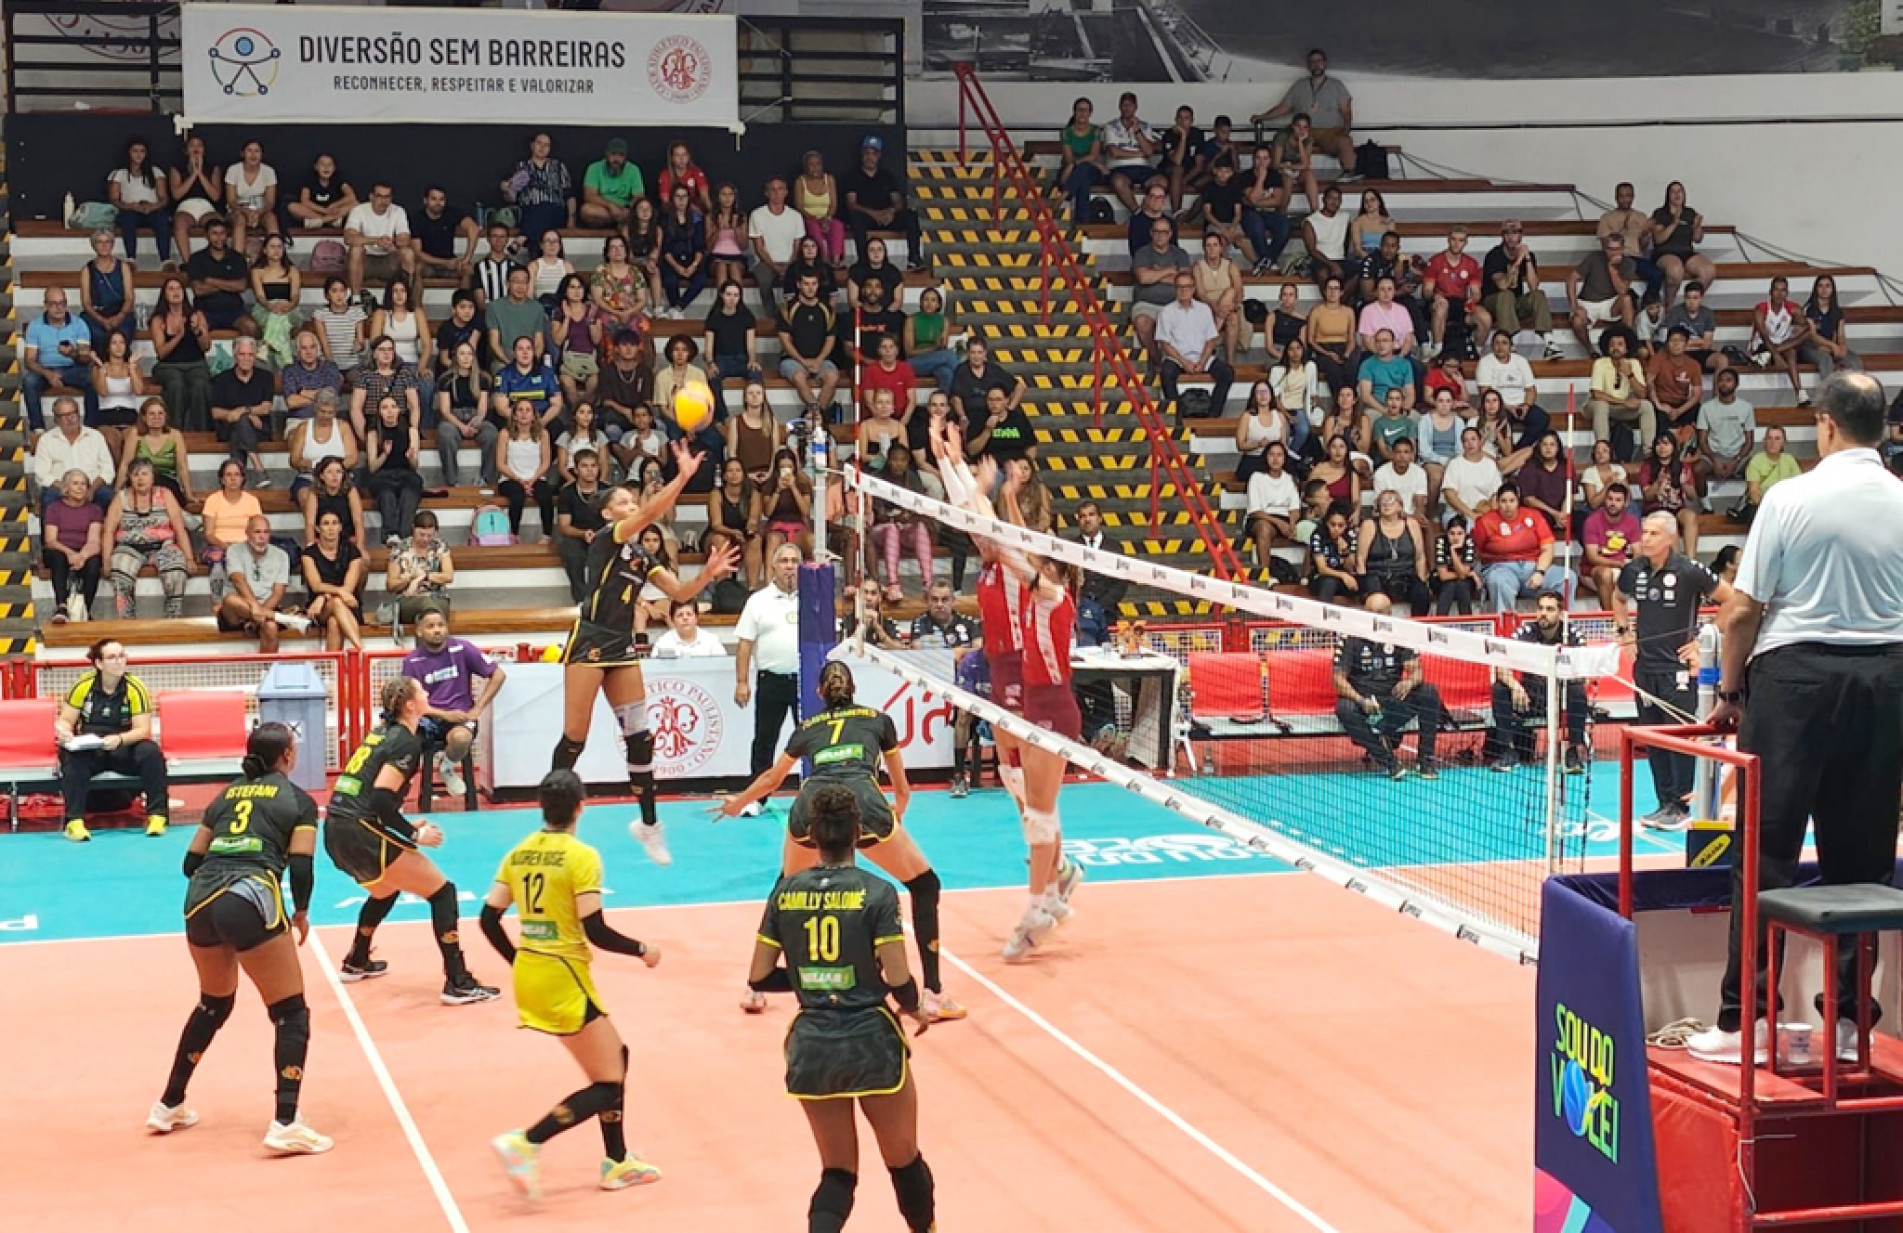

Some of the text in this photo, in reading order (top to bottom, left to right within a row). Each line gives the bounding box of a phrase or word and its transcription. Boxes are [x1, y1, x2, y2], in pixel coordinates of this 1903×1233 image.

[299, 31, 626, 68] DIVERSÃO SEM BARREIRAS
[333, 75, 595, 94] RECONHECER, RESPEITAR E VALORIZAR
[621, 584, 633, 605] 4
[826, 718, 846, 746] 7
[229, 799, 254, 834] 3
[521, 872, 545, 915] 12
[803, 915, 841, 963] 10
[1555, 1002, 1615, 1088] SOU DO
